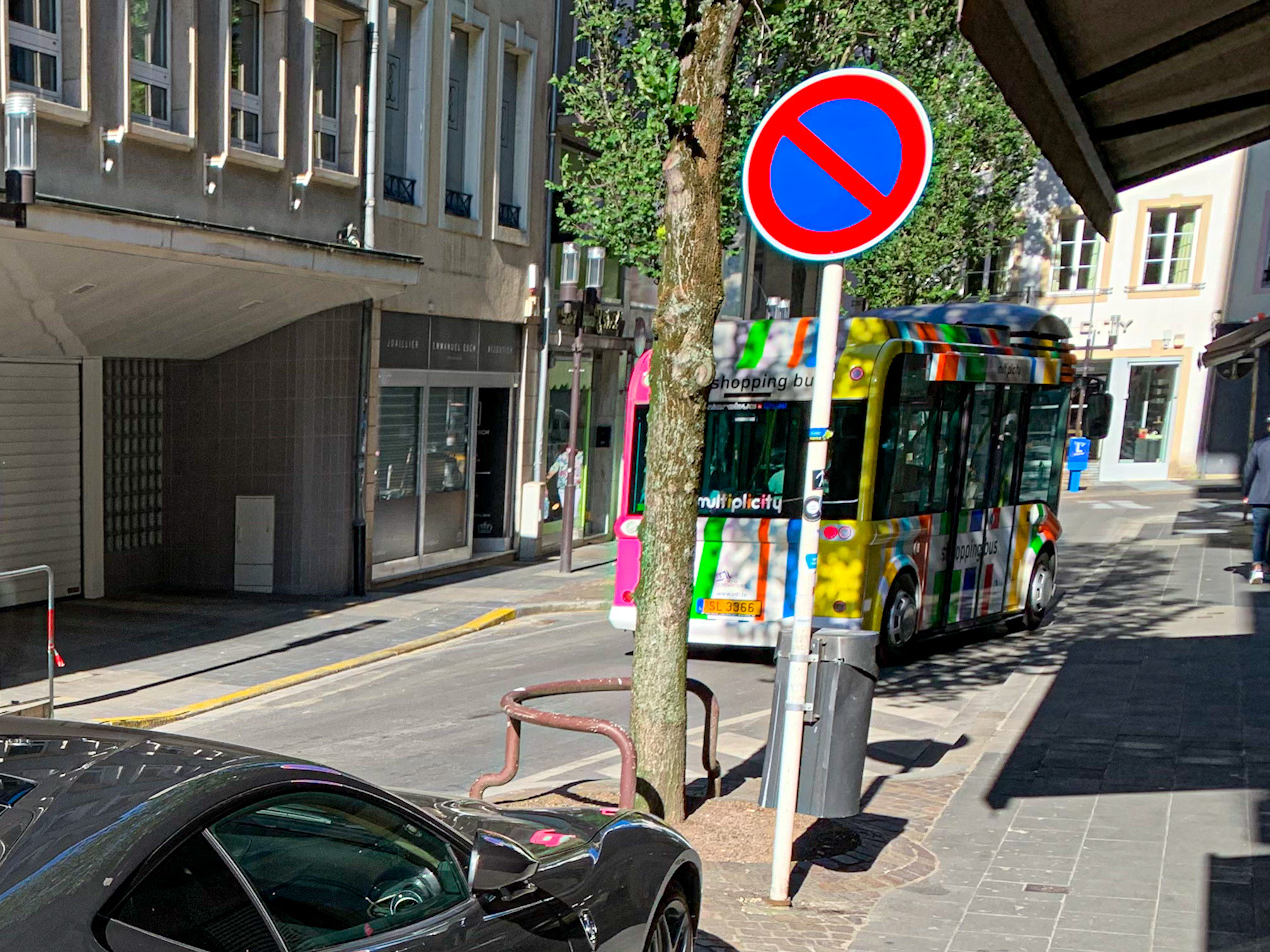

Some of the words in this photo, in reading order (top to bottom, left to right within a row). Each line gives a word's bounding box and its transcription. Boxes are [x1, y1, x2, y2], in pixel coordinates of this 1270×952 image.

[710, 374, 787, 391] shopping
[793, 373, 815, 388] bu
[697, 490, 783, 514] multiplicity
[940, 538, 984, 563] sopping
[708, 601, 723, 612] SL
